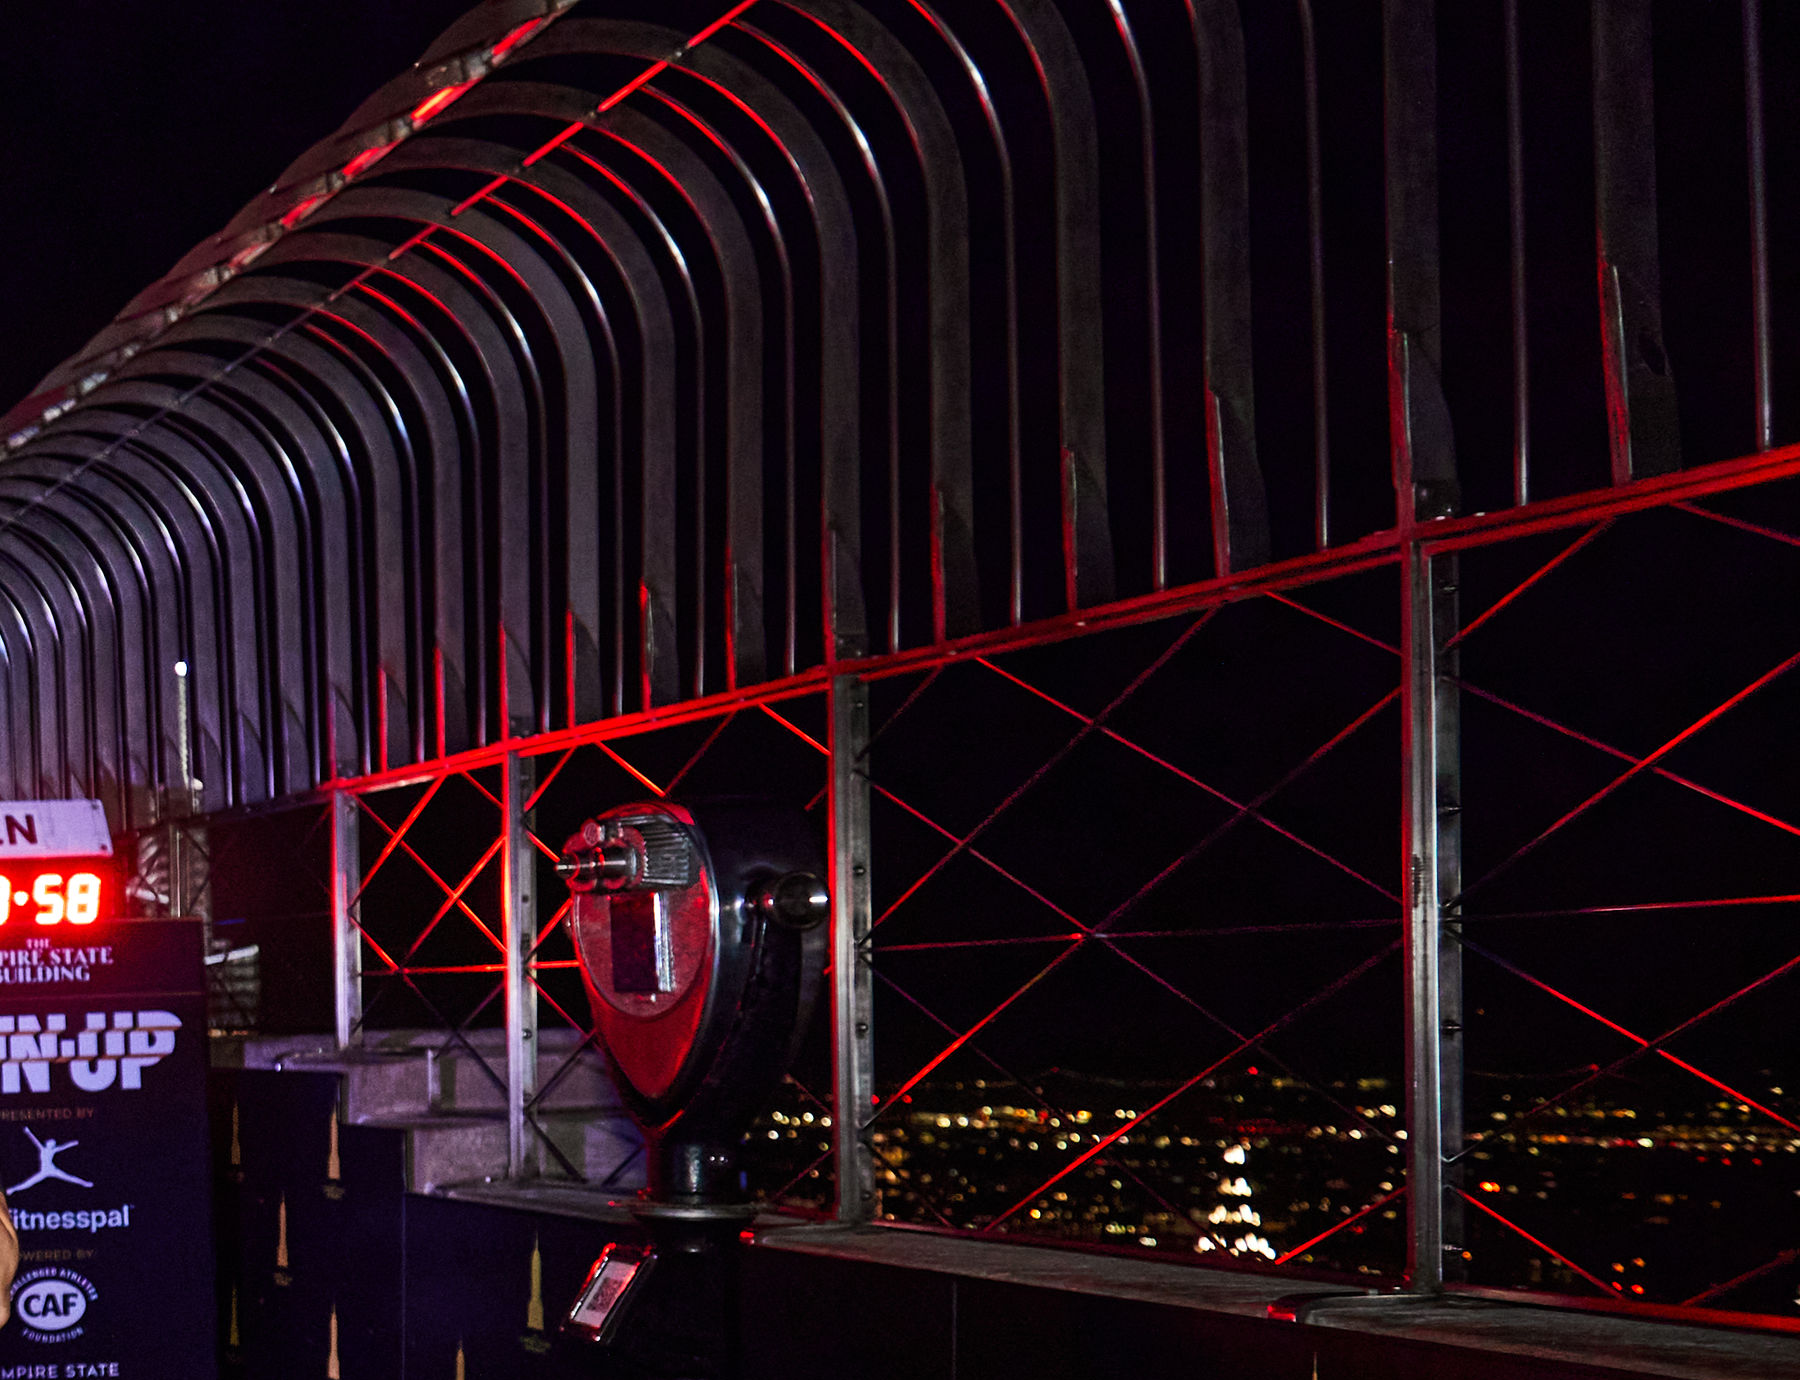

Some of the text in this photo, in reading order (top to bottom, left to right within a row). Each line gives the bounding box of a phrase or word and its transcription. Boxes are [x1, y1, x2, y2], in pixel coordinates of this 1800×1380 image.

[26, 938, 50, 949] THE
[49, 946, 114, 966] STATE
[9, 1204, 131, 1234] itnesspal
[20, 1249, 73, 1261] WERED
[24, 1293, 78, 1317] CAF
[65, 1361, 119, 1379] STATE
